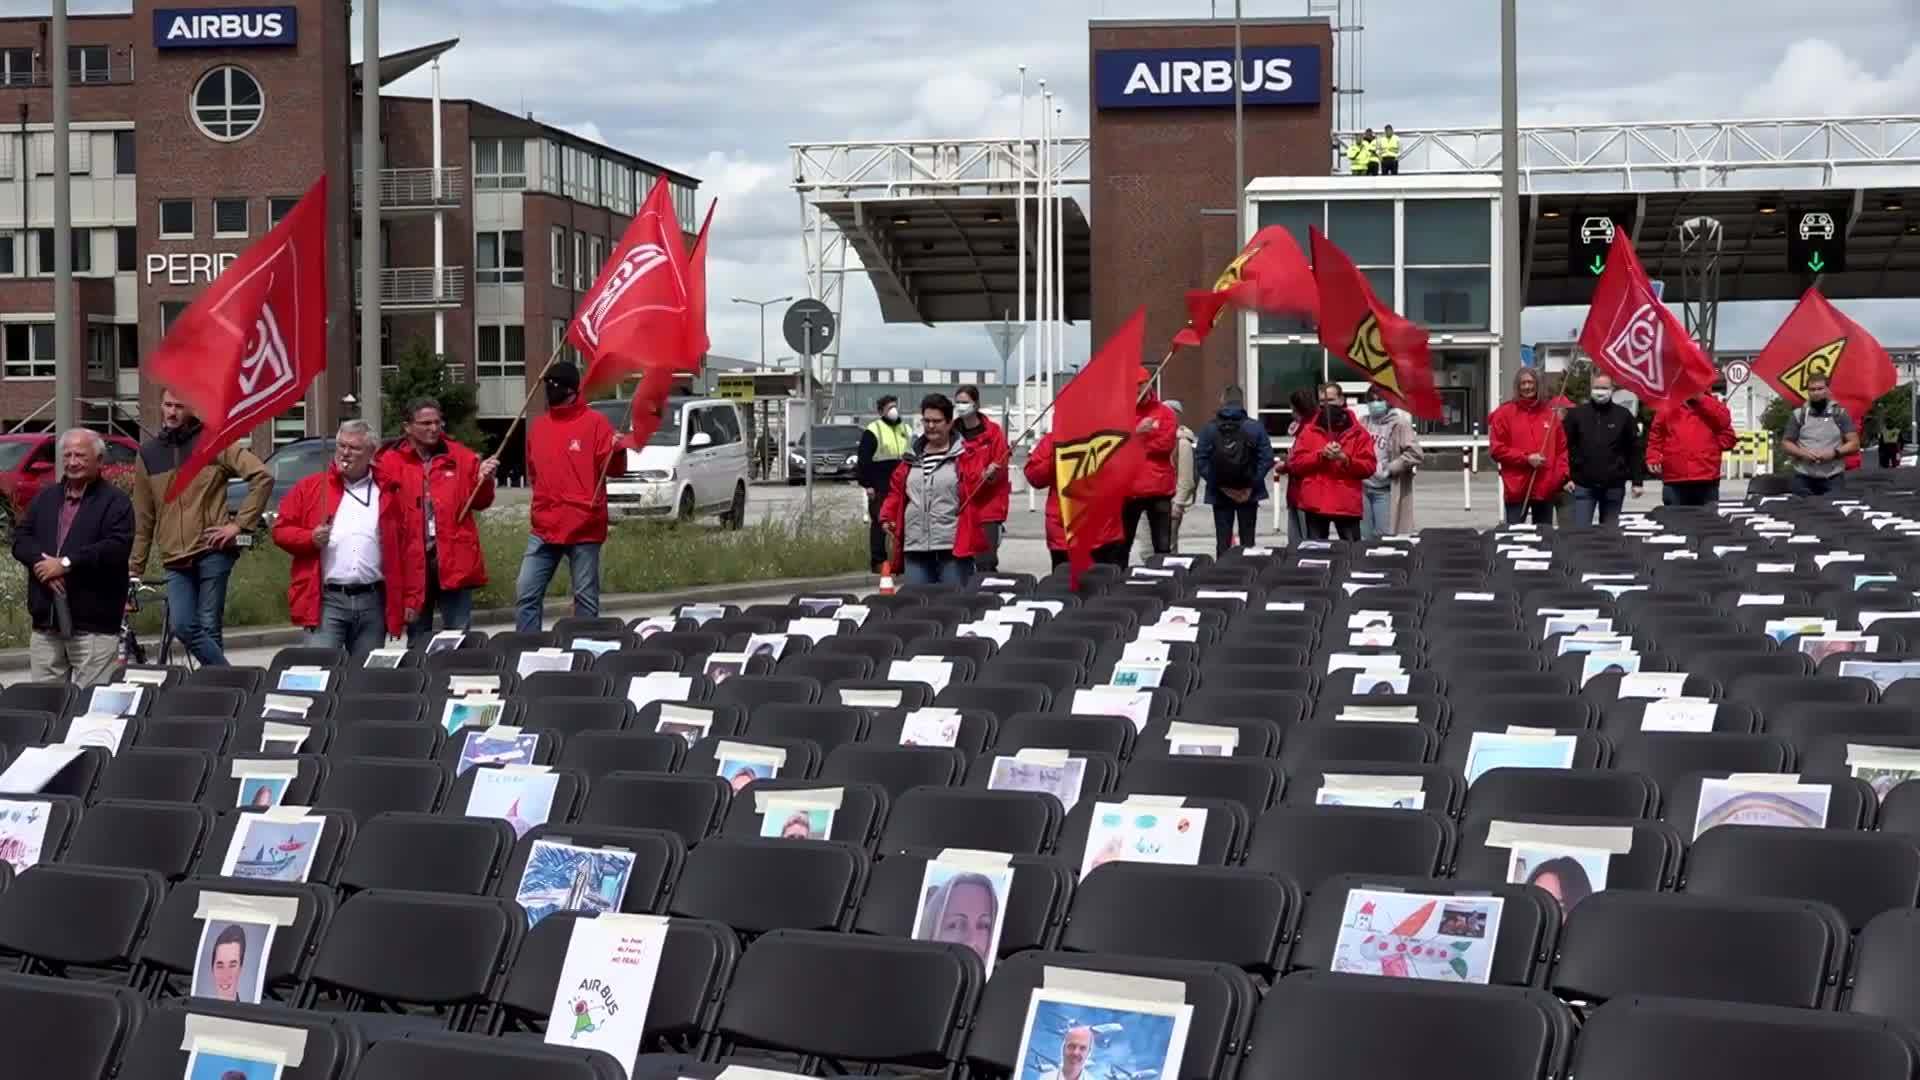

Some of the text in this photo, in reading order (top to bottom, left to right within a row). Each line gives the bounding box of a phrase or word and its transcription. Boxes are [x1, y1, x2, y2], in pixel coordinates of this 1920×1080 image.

[166, 12, 284, 40] AIRBUS
[1122, 58, 1293, 95] AIRBUS
[1732, 367, 1742, 380] 10
